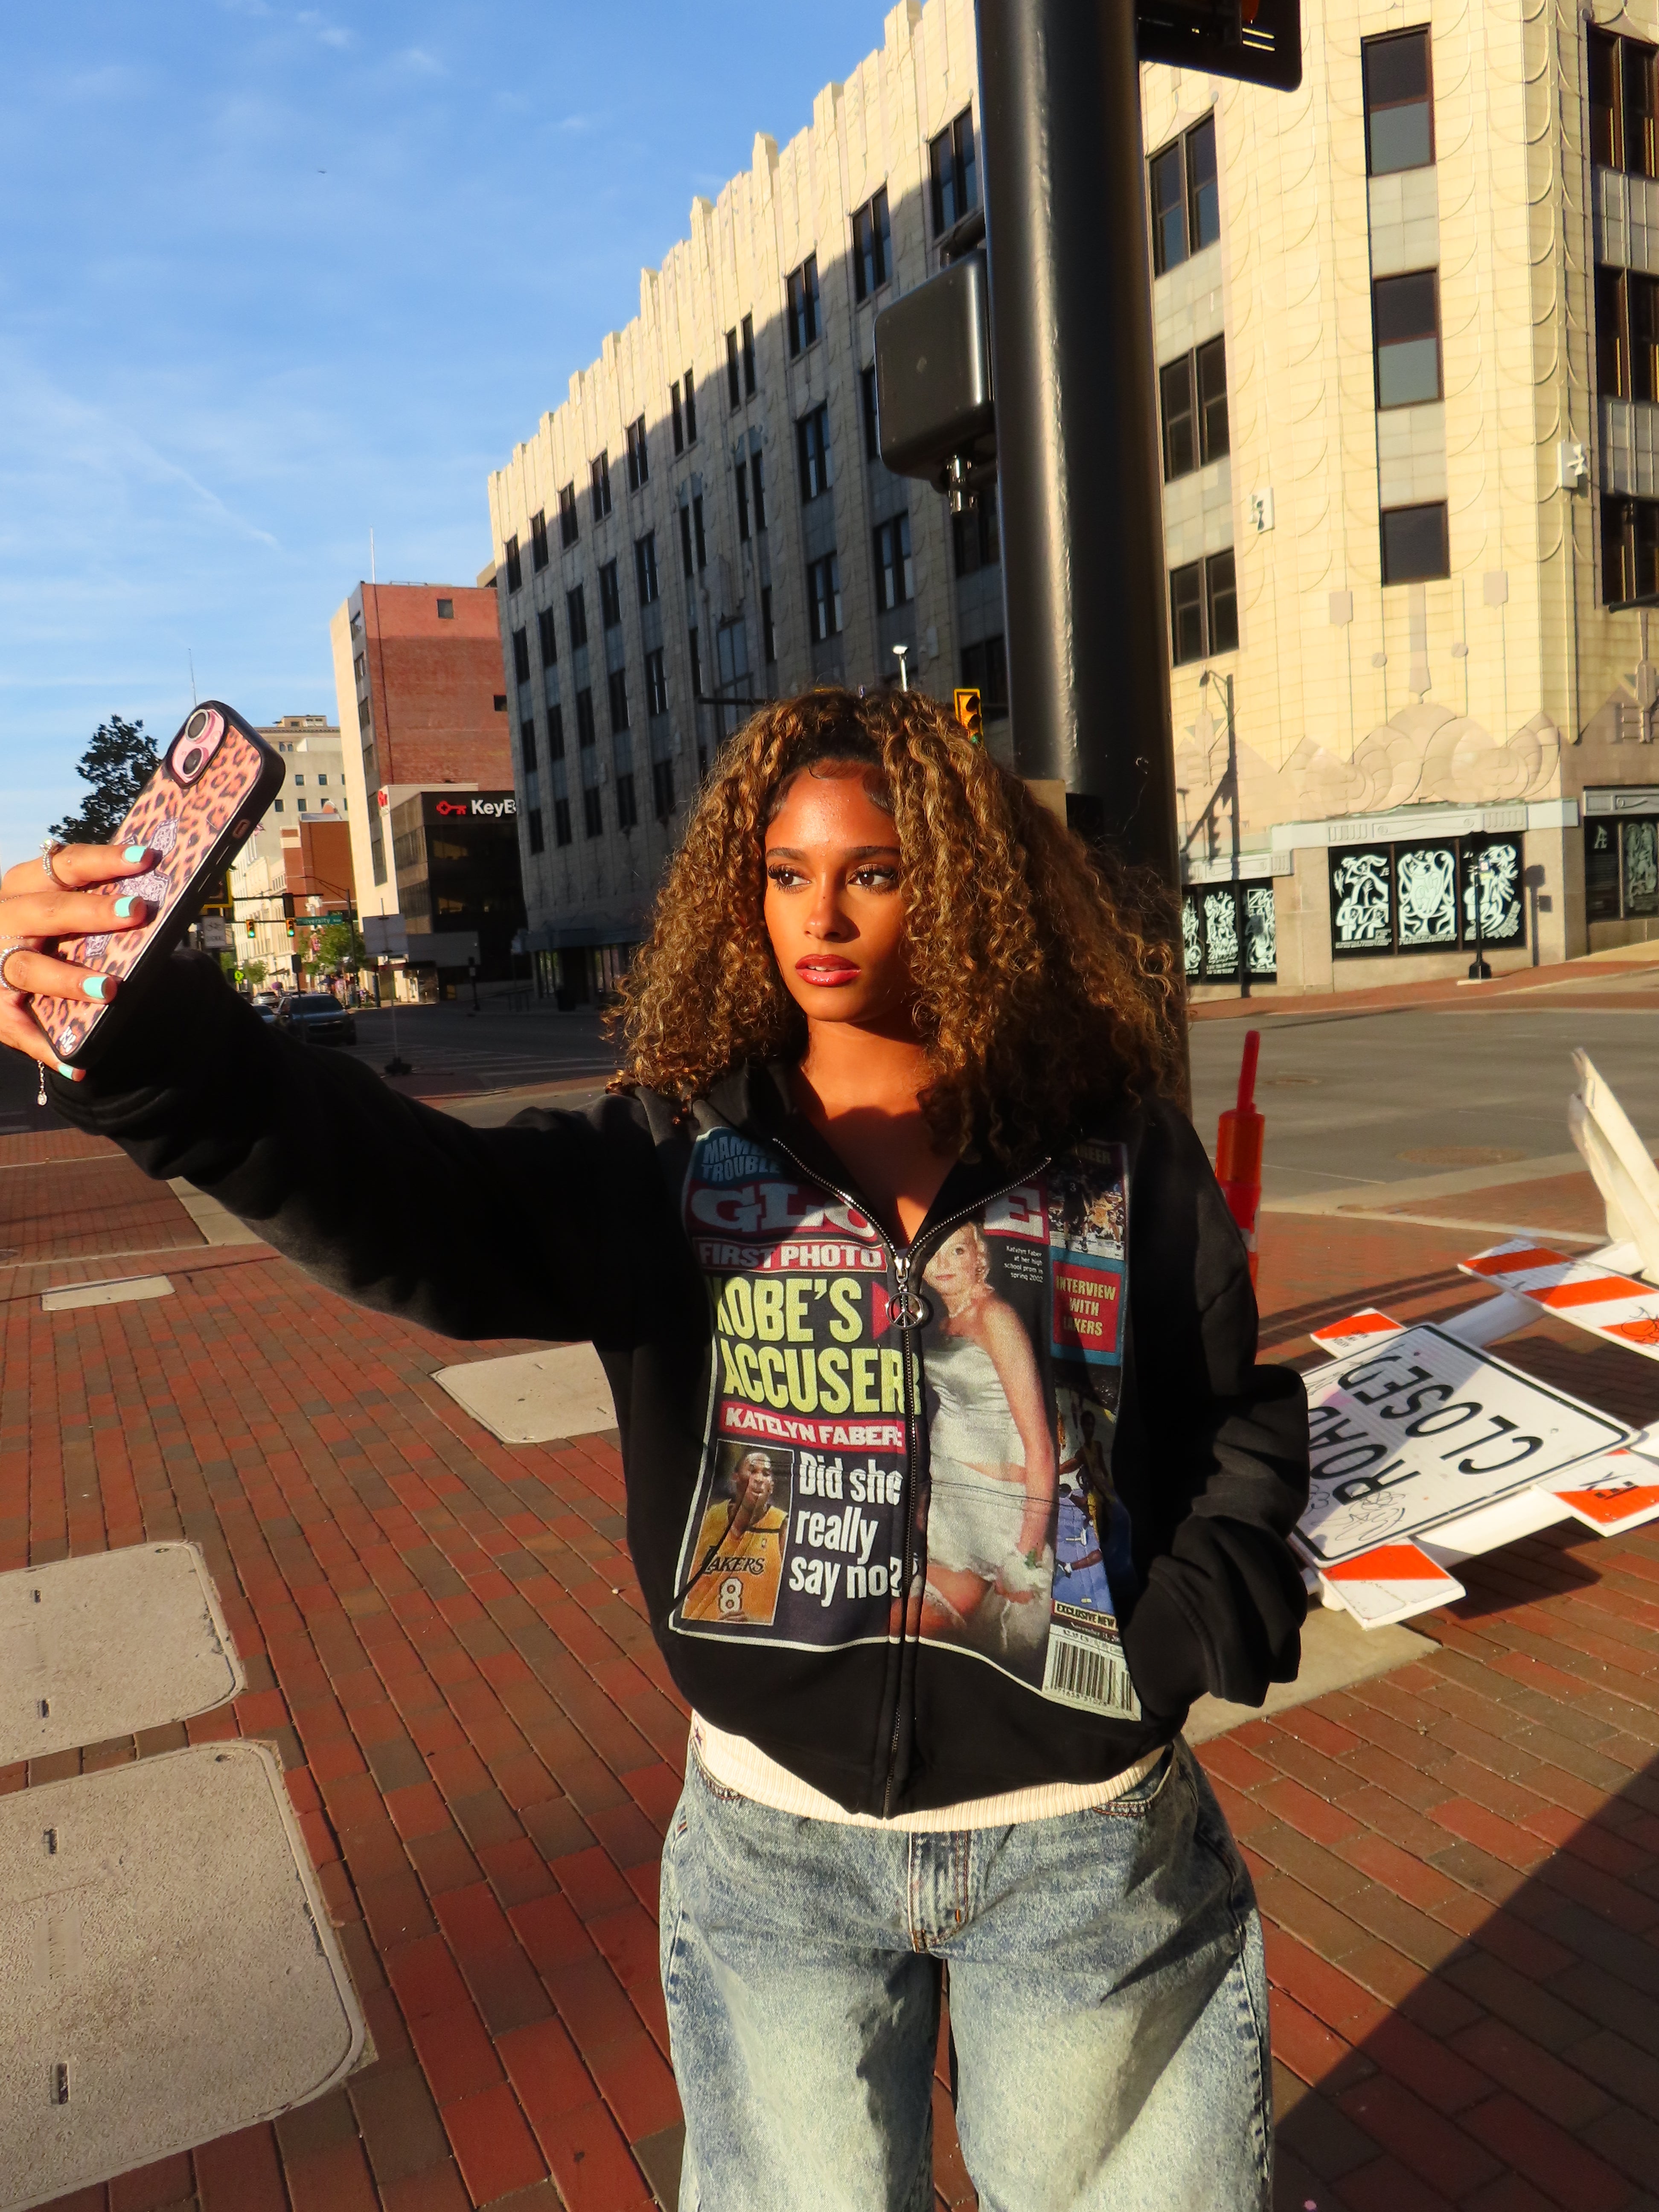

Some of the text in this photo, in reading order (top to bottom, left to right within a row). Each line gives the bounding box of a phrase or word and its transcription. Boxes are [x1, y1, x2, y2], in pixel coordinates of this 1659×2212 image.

[701, 1154, 781, 1182] TROUBLE
[699, 1242, 882, 1269] FIRST PHOTO
[1056, 1275, 1116, 1301] INTERVIEW
[1069, 1297, 1100, 1317] WITH
[720, 1338, 922, 1415] ACCUSER
[725, 1407, 903, 1448] KATELYN FABER:
[1337, 1355, 1543, 1475] CLOSED
[799, 1452, 903, 1506] Did she
[795, 1506, 879, 1565] really
[719, 1576, 744, 1613] 8
[789, 1556, 903, 1608] say no?
